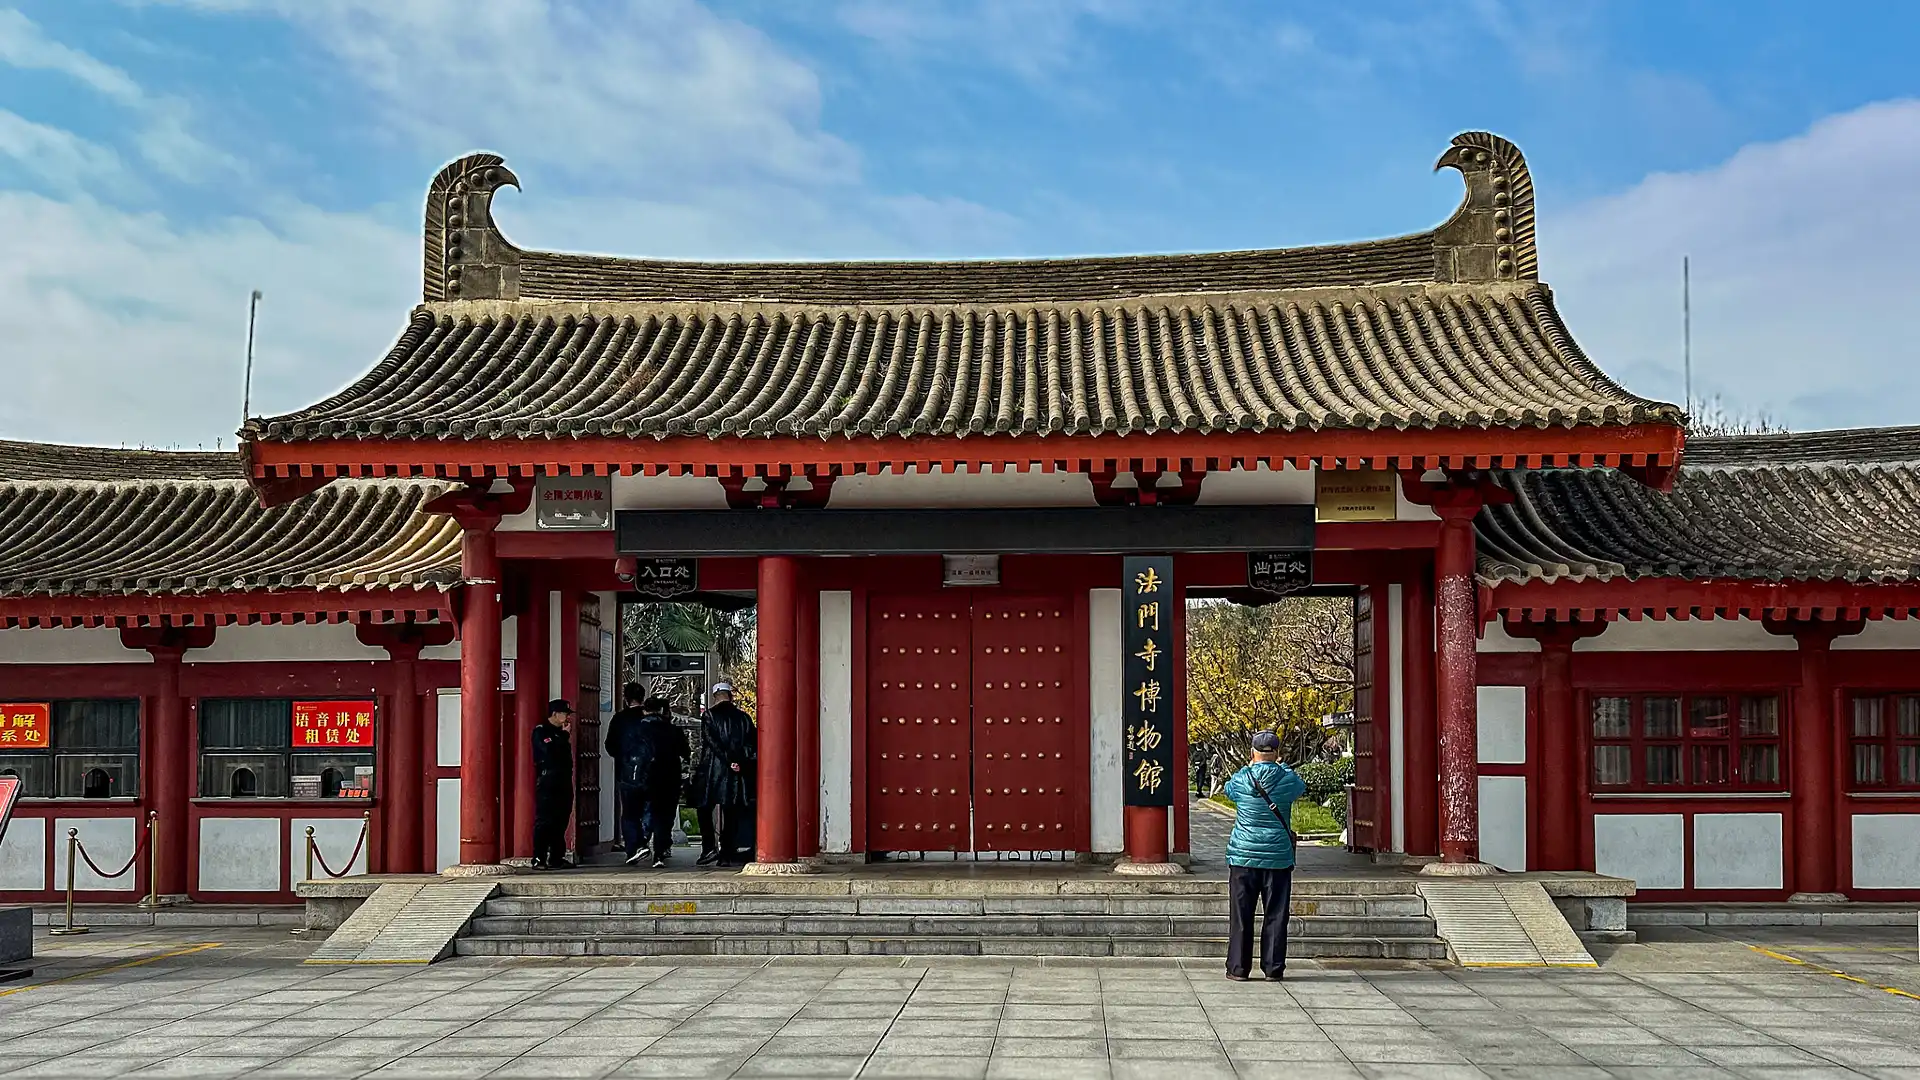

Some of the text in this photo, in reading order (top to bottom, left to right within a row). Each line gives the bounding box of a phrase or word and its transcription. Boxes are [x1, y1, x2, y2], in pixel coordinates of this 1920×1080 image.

[641, 566, 690, 577] 入口处
[1254, 561, 1306, 574] 出口处
[1133, 567, 1164, 794] 法門寺博物館
[295, 712, 370, 727] 语音讲解
[1, 729, 40, 742] 系处
[305, 728, 360, 743] 租赁处
